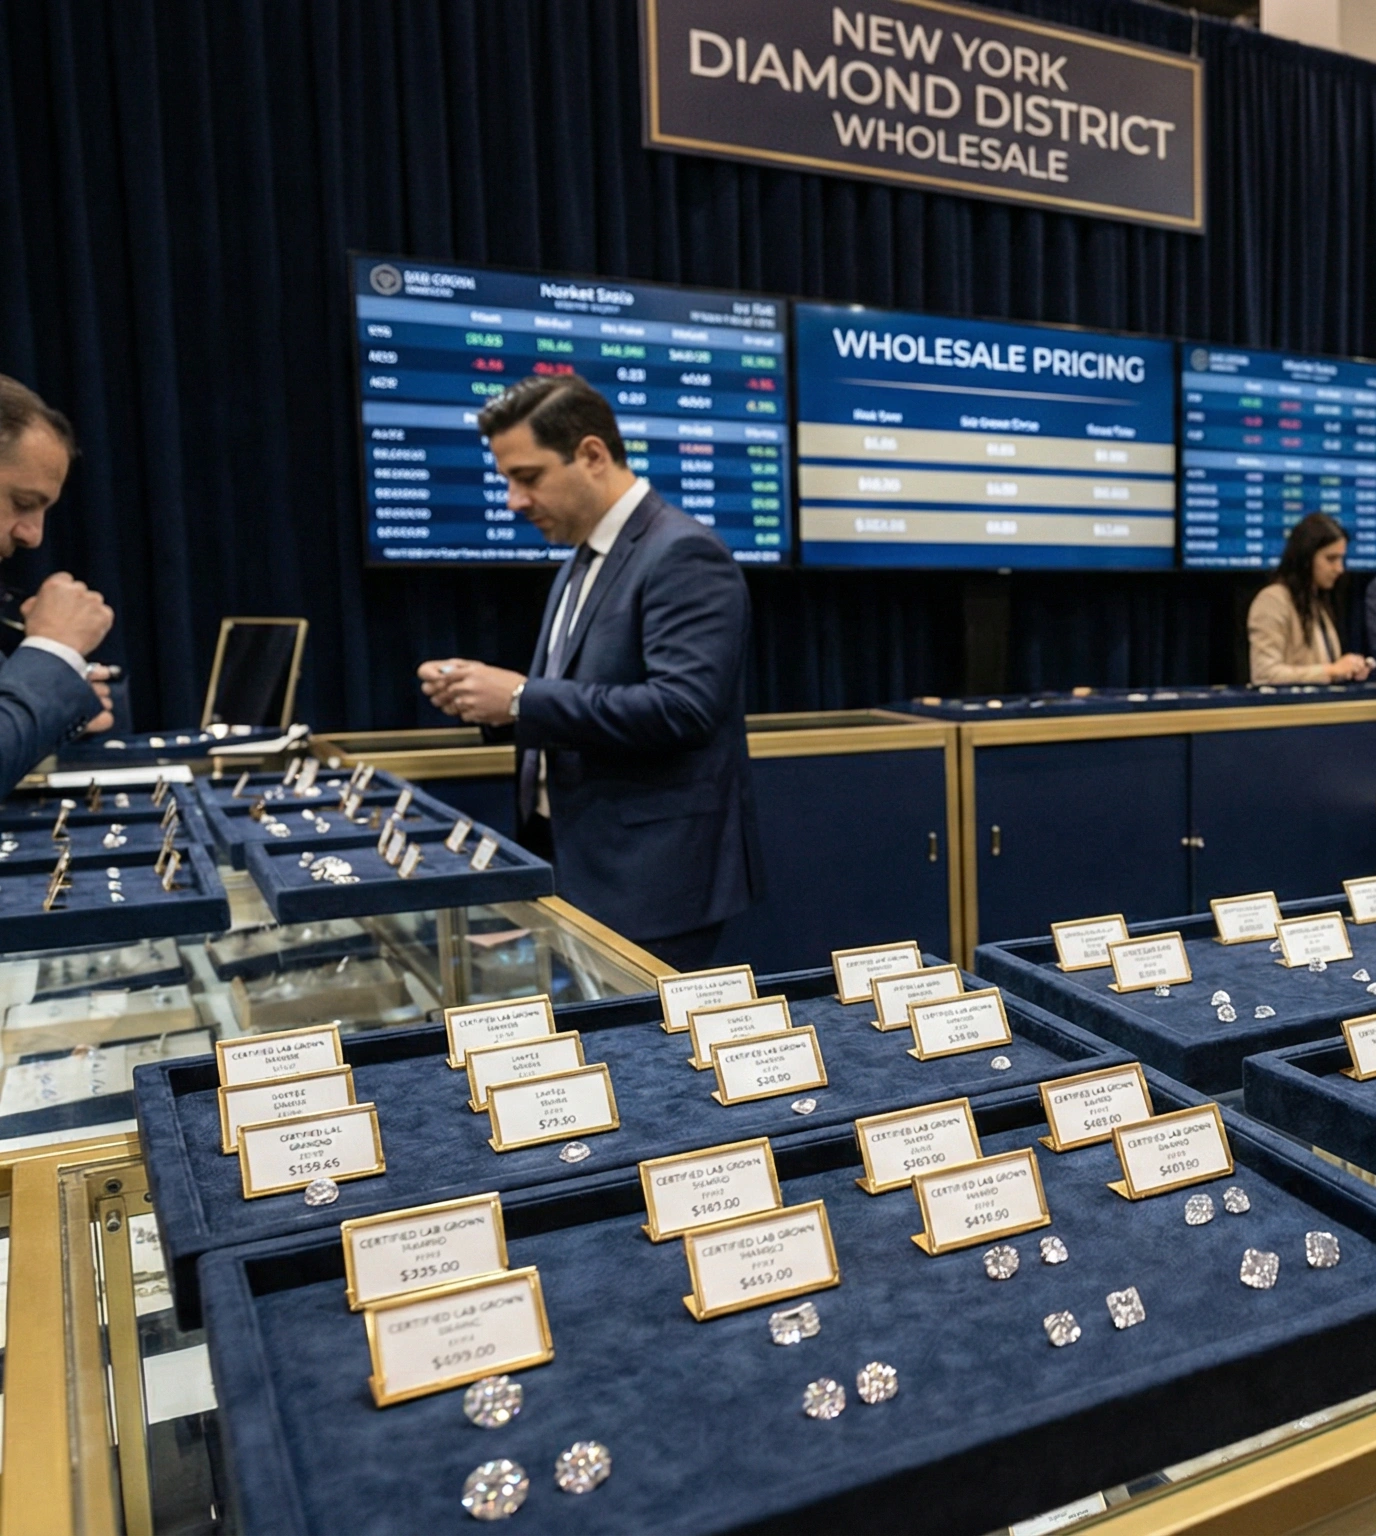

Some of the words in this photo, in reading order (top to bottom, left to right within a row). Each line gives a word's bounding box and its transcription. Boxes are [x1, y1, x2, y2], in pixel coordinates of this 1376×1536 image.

[833, 6, 943, 64] NEW
[952, 31, 1068, 92] YORK
[688, 28, 961, 119] DIAMOND
[975, 84, 1175, 159] DISTRICT
[833, 110, 1069, 183] WHOLESALE
[832, 327, 1027, 374] WHOLESALE
[1032, 346, 1146, 384] PRICING
